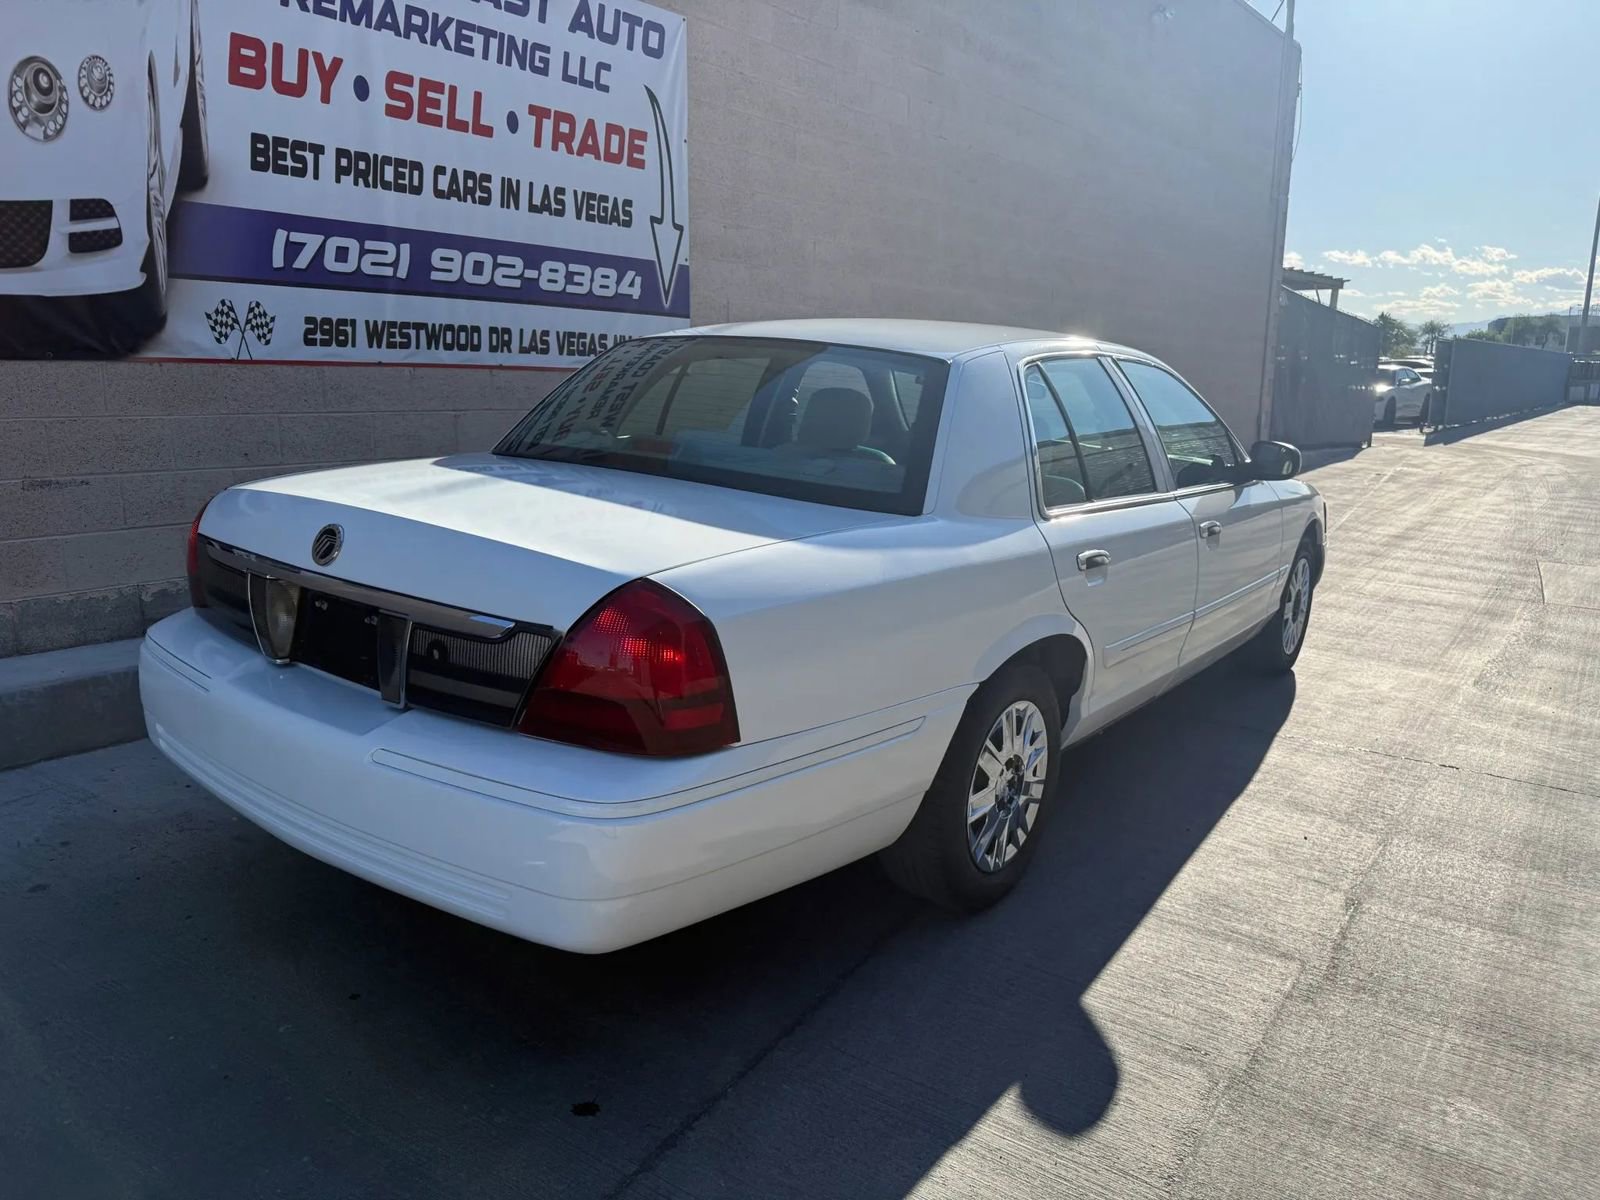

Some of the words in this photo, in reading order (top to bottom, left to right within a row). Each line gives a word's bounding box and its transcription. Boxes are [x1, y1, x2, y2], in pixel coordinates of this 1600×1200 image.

[568, 0, 666, 60] AUTO
[228, 32, 344, 105] BUY
[384, 70, 494, 138] SELL
[528, 104, 648, 170] TRADE
[562, 51, 612, 93] LLC
[250, 132, 326, 181] BEST
[335, 147, 424, 197] PRICED
[433, 165, 492, 206] CARS
[500, 176, 520, 211] IN
[528, 181, 566, 218] LAS
[573, 189, 633, 229] VEGAS
[272, 228, 410, 279] (702)
[430, 247, 642, 300] 902-8384
[303, 316, 357, 348] 2961
[364, 319, 482, 352] WESTWOOD
[488, 326, 513, 354] DR
[518, 328, 550, 355] LAS
[556, 330, 608, 357] VEGAS
